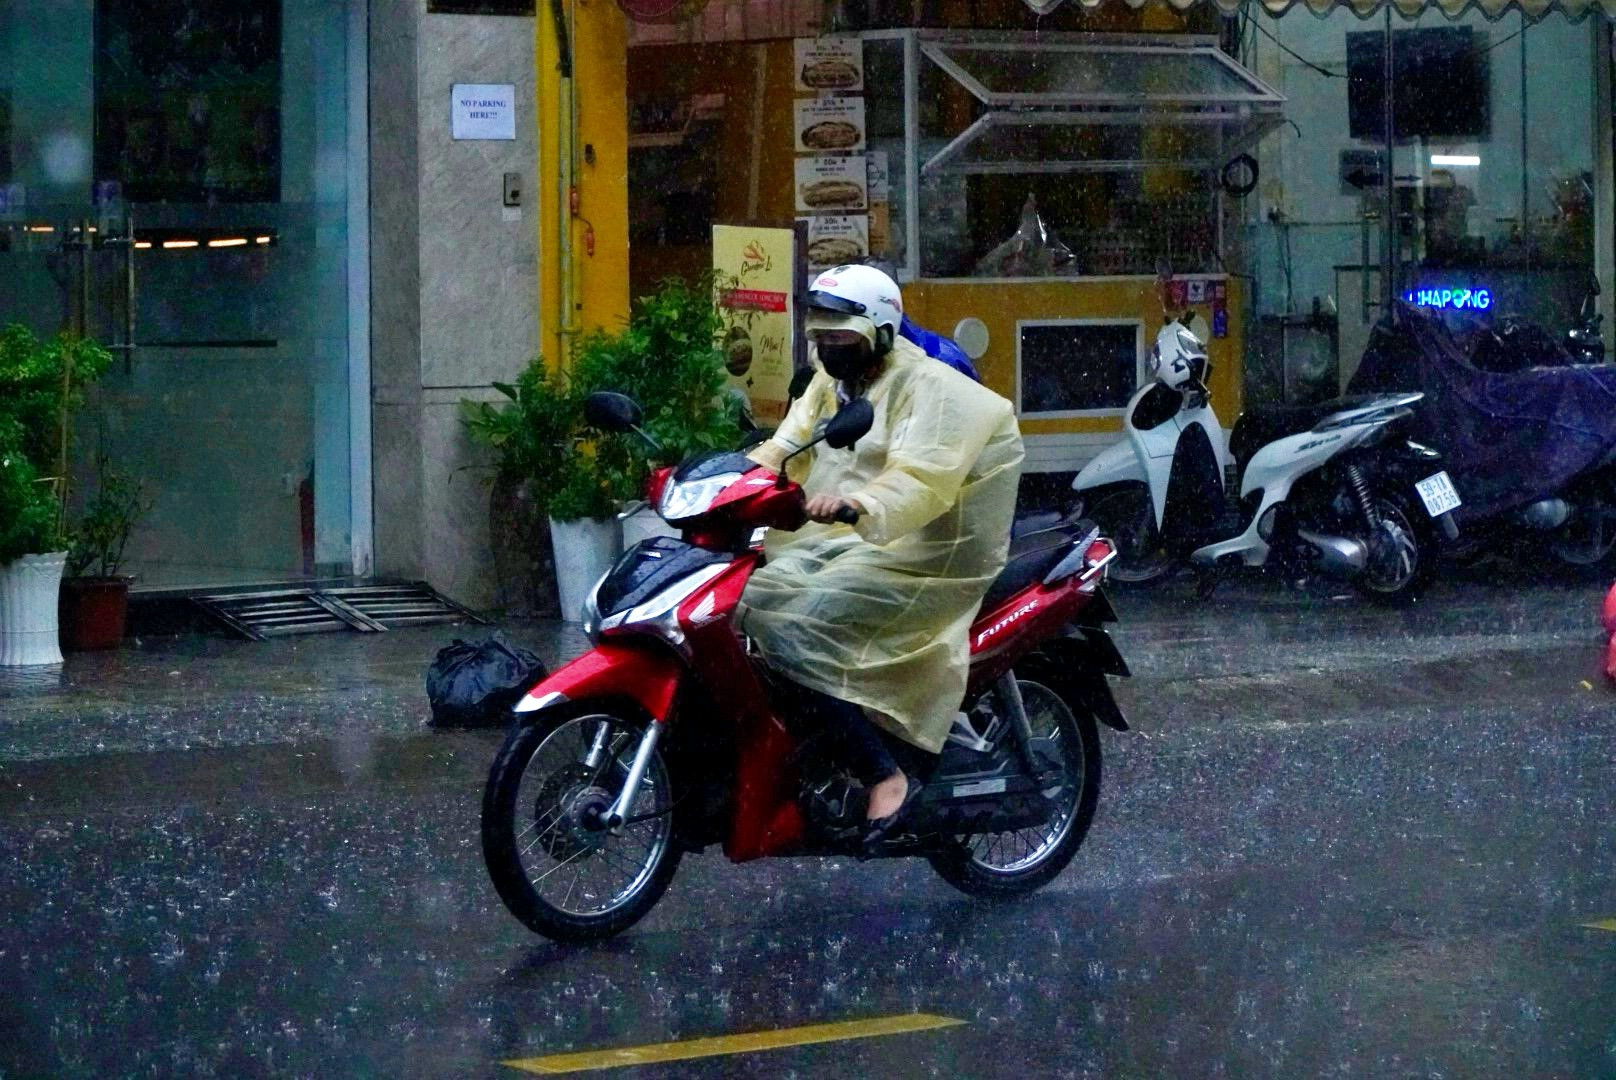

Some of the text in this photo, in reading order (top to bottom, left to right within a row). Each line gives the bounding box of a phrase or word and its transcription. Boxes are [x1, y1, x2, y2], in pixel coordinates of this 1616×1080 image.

[473, 100, 506, 108] PARKING
[470, 111, 498, 119] HERE!!!
[976, 599, 1039, 647] FUTURE
